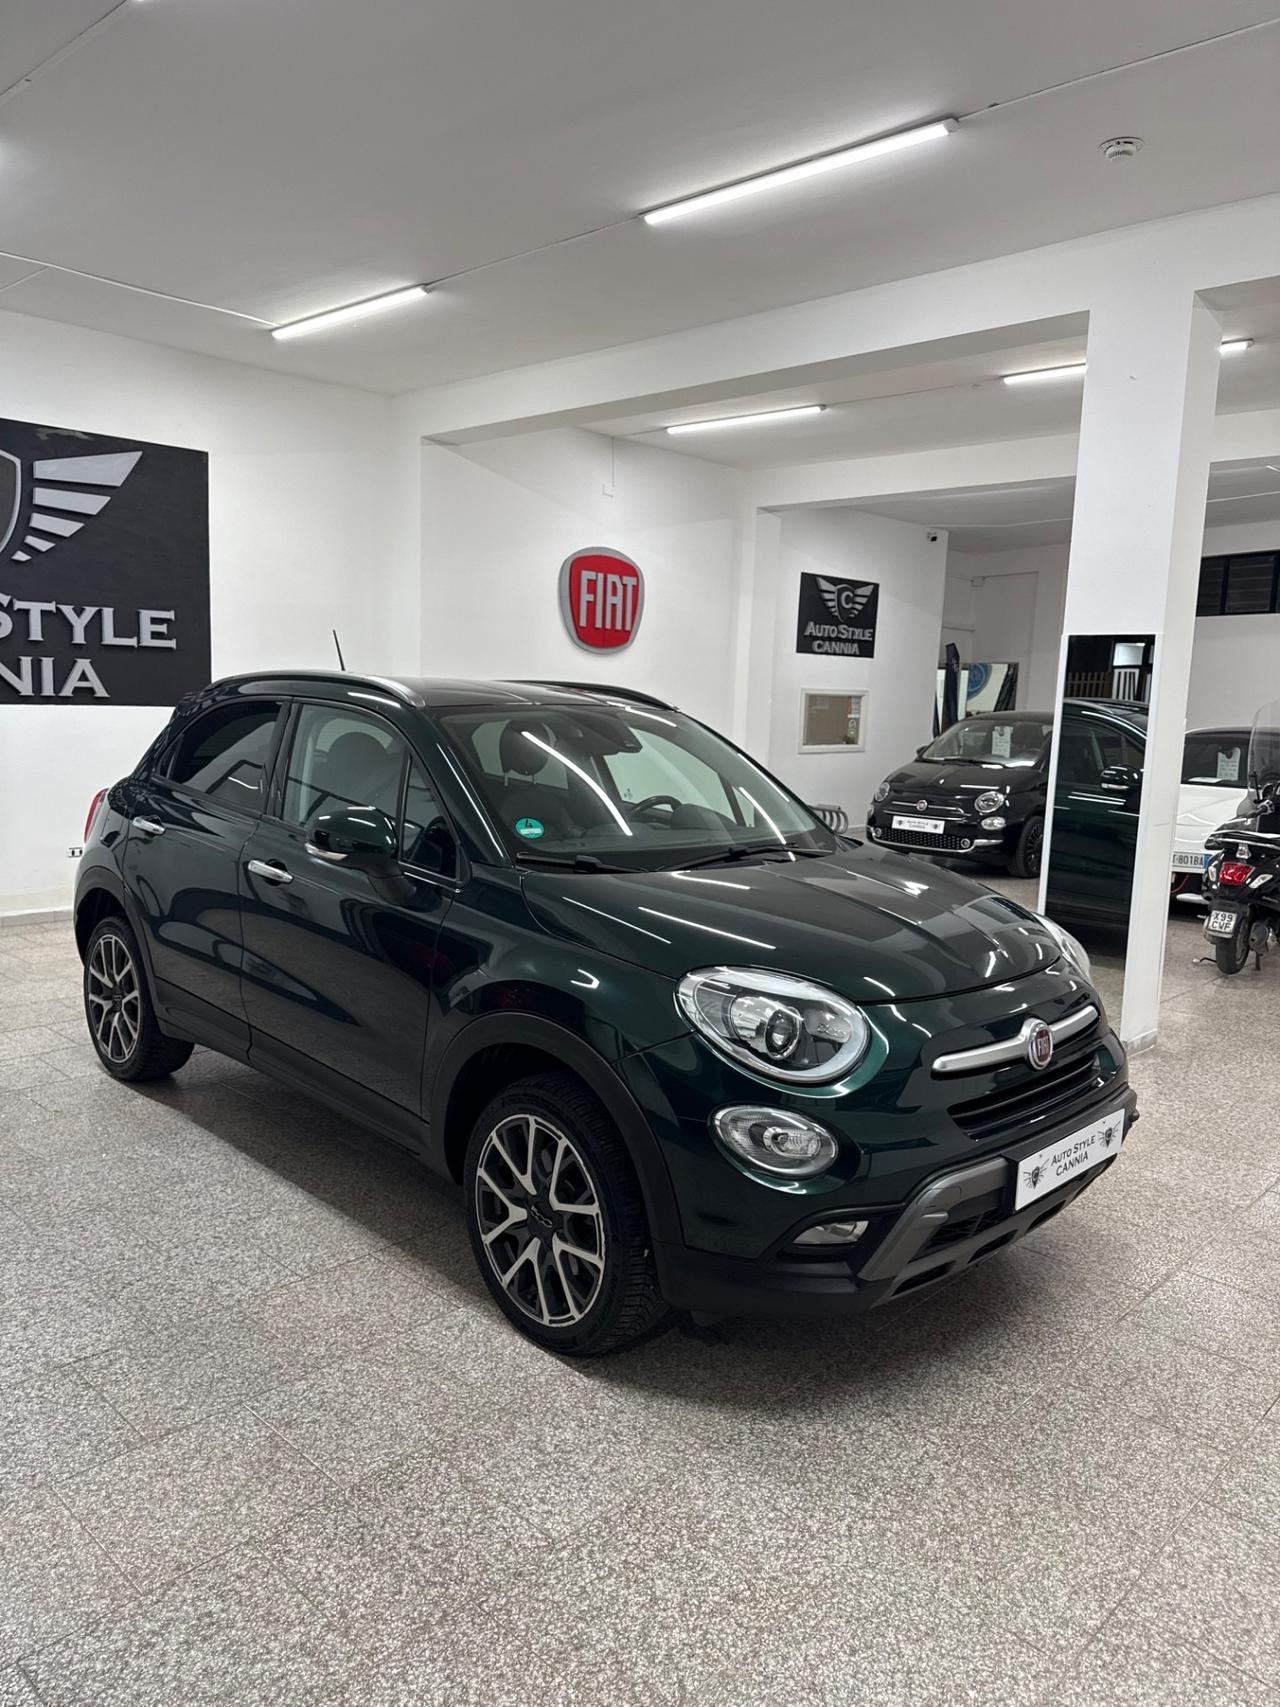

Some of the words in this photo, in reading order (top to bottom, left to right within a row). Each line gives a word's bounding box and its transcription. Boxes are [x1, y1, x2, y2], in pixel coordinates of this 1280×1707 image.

[579, 569, 637, 631] FIAT
[841, 591, 854, 609] C
[812, 640, 860, 656] CANNIA
[1056, 1151, 1089, 1176] CANNIA
